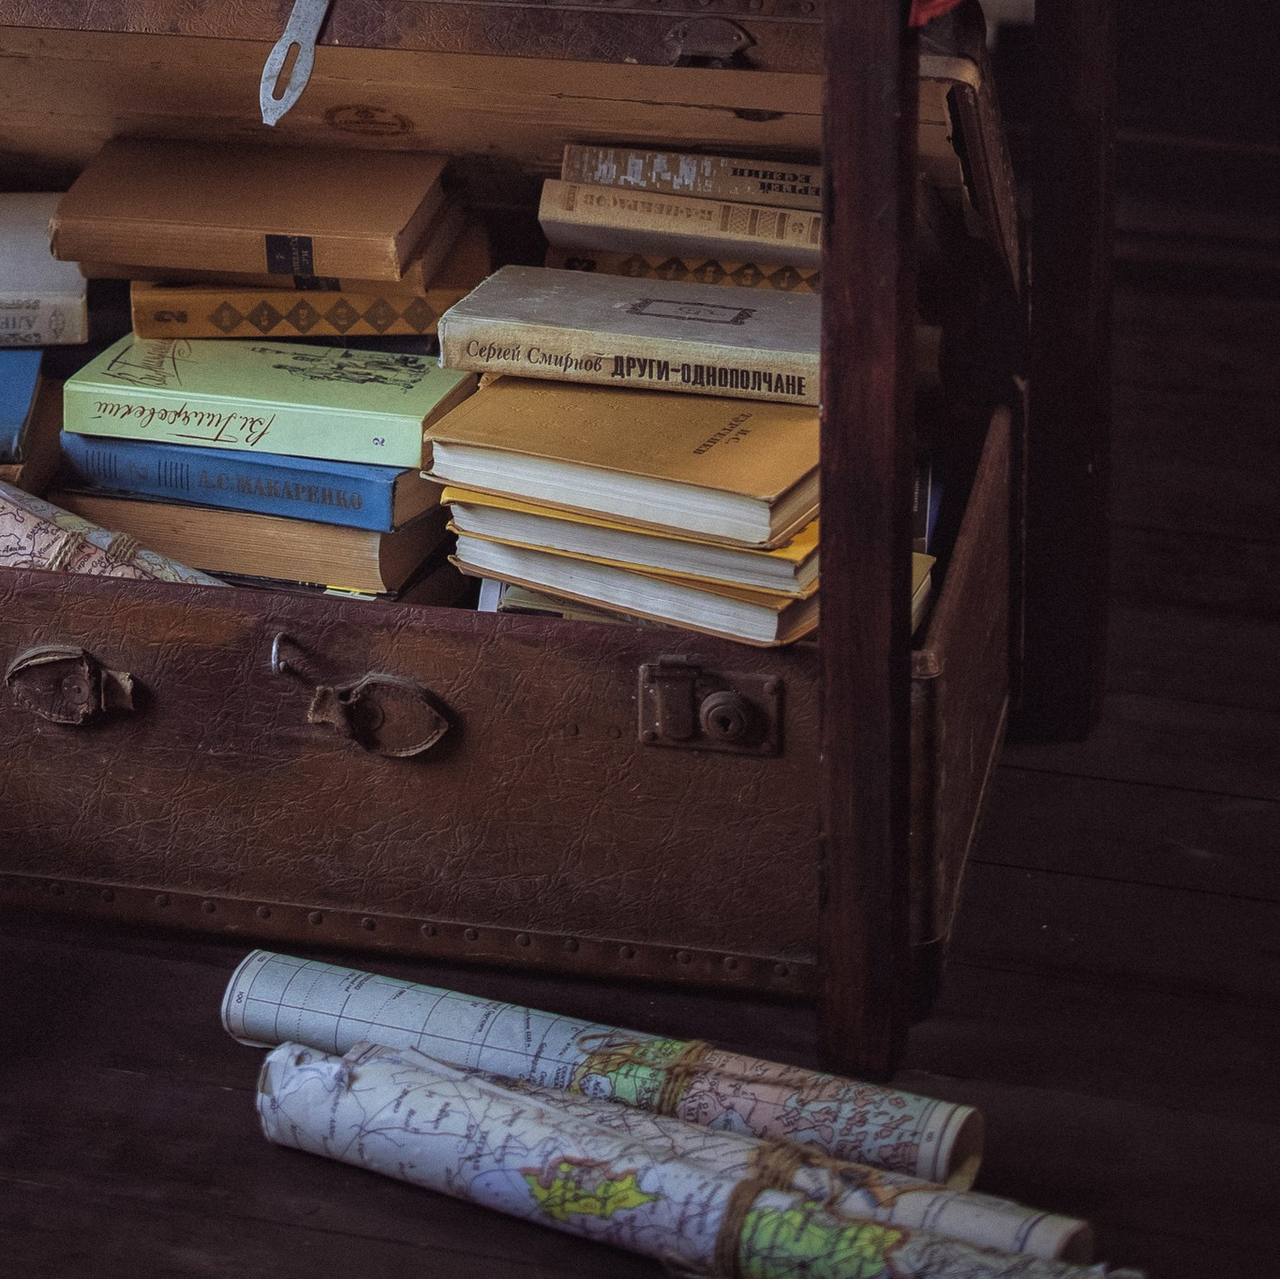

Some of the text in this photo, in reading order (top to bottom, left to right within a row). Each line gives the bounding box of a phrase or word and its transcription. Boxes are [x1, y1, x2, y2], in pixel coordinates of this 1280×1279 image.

[730, 167, 812, 185] ЕСЕНИН
[757, 181, 821, 197] ЕРГЕЙ
[465, 337, 807, 398] Сергей Смирнов ДРУГИ-ОДНОПОЛЧАНЕ
[693, 412, 753, 455] ТУРГЕНЕВ
